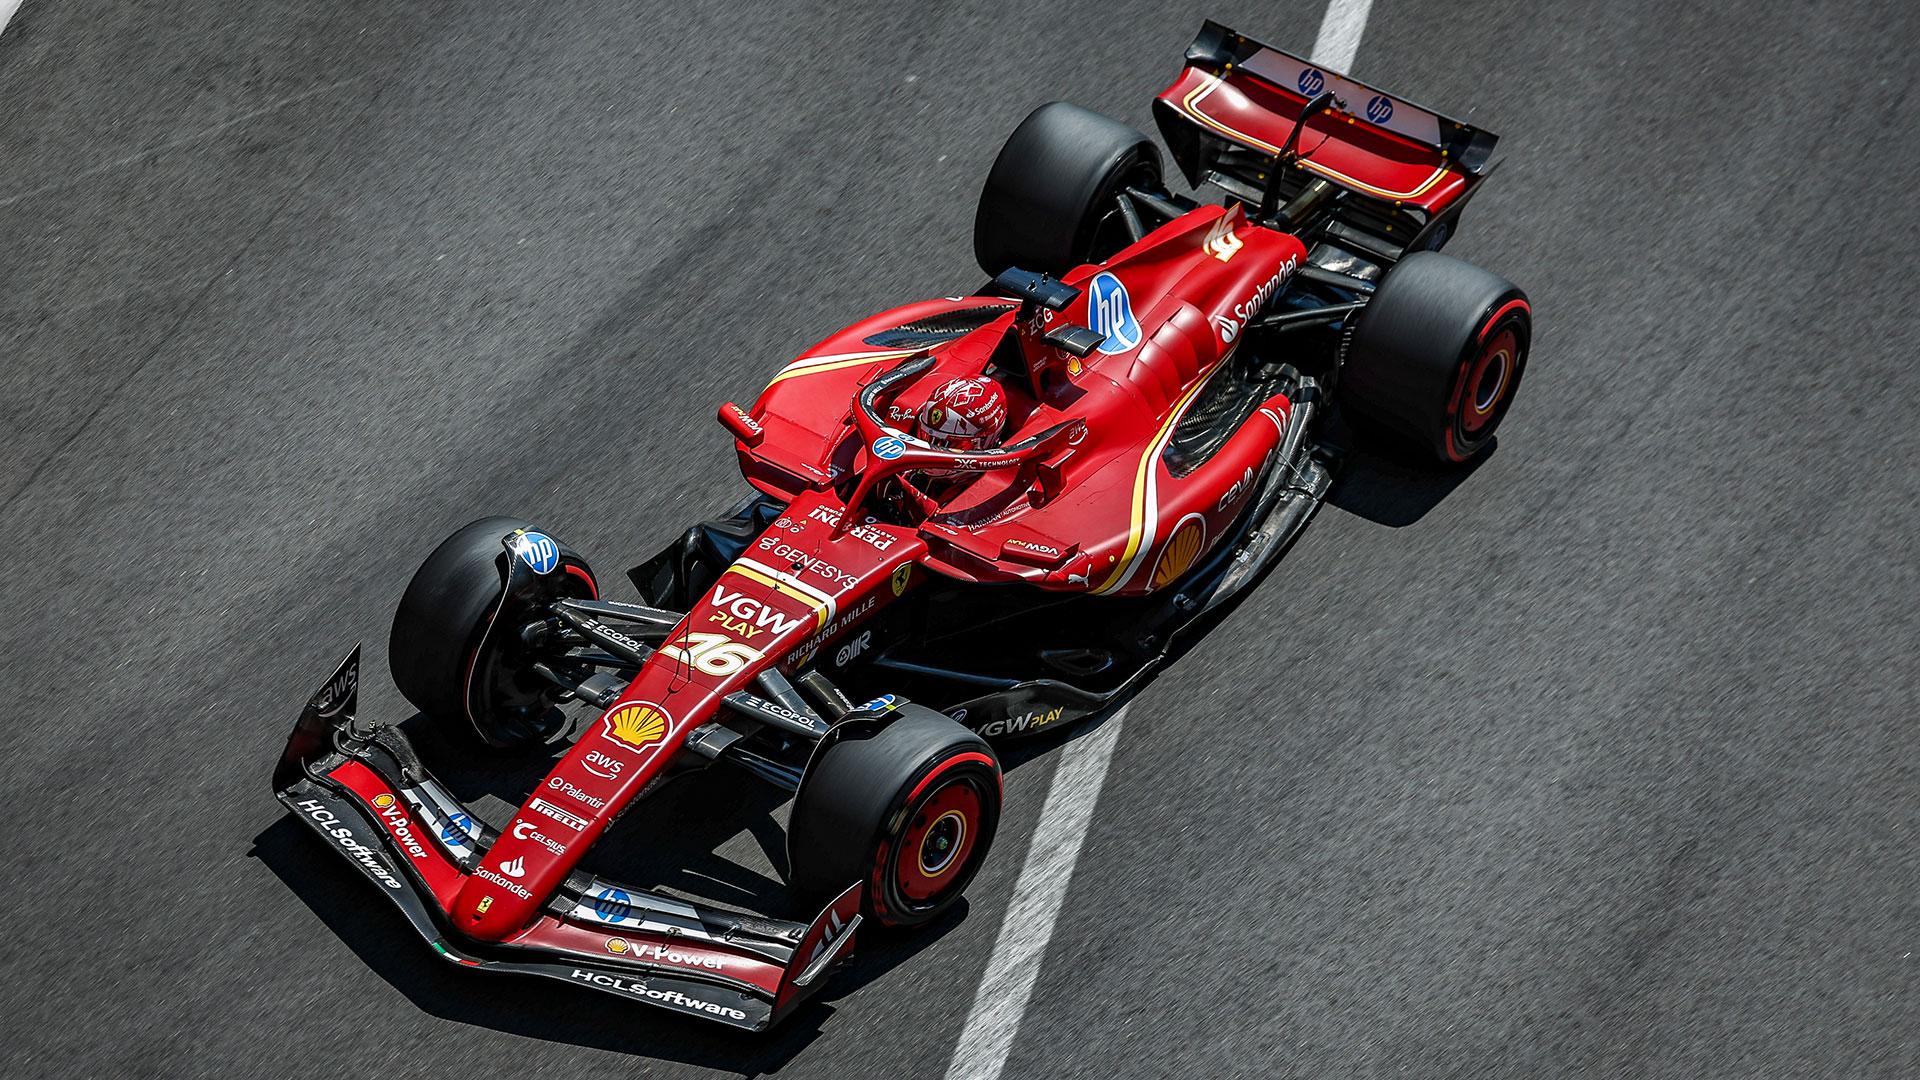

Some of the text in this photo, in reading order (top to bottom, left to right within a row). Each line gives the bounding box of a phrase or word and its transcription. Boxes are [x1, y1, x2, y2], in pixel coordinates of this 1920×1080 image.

[1299, 68, 1323, 95] hp
[1368, 96, 1392, 123] hp
[1235, 253, 1297, 329] Santander
[1093, 280, 1134, 347] hp
[889, 405, 916, 421] Ray-Ban
[873, 438, 905, 460] hp
[953, 457, 1020, 470] DXC TECHNOLOGY
[864, 524, 898, 542] NASTRO
[523, 533, 558, 574] hp
[1024, 542, 1059, 556] VGW
[774, 543, 859, 590] GENESYS
[709, 610, 764, 640] PLAY
[711, 585, 799, 636] VGW
[596, 624, 643, 650] ECOPOL
[787, 595, 876, 665] RICHARD MILLE
[658, 632, 766, 676] 16
[322, 662, 357, 703] aws
[761, 700, 815, 730] ECOPOL
[1030, 706, 1064, 729] PLAY
[585, 750, 625, 774] aws
[560, 782, 605, 809] Palantir
[528, 797, 589, 832] PIRELLI
[297, 799, 403, 889] HCLSoftware
[381, 807, 428, 859] V-Power
[529, 831, 567, 853] CELSIUS
[472, 865, 533, 901] Santander
[634, 941, 728, 970] V-Power
[570, 969, 747, 1021] HCLSoftware
